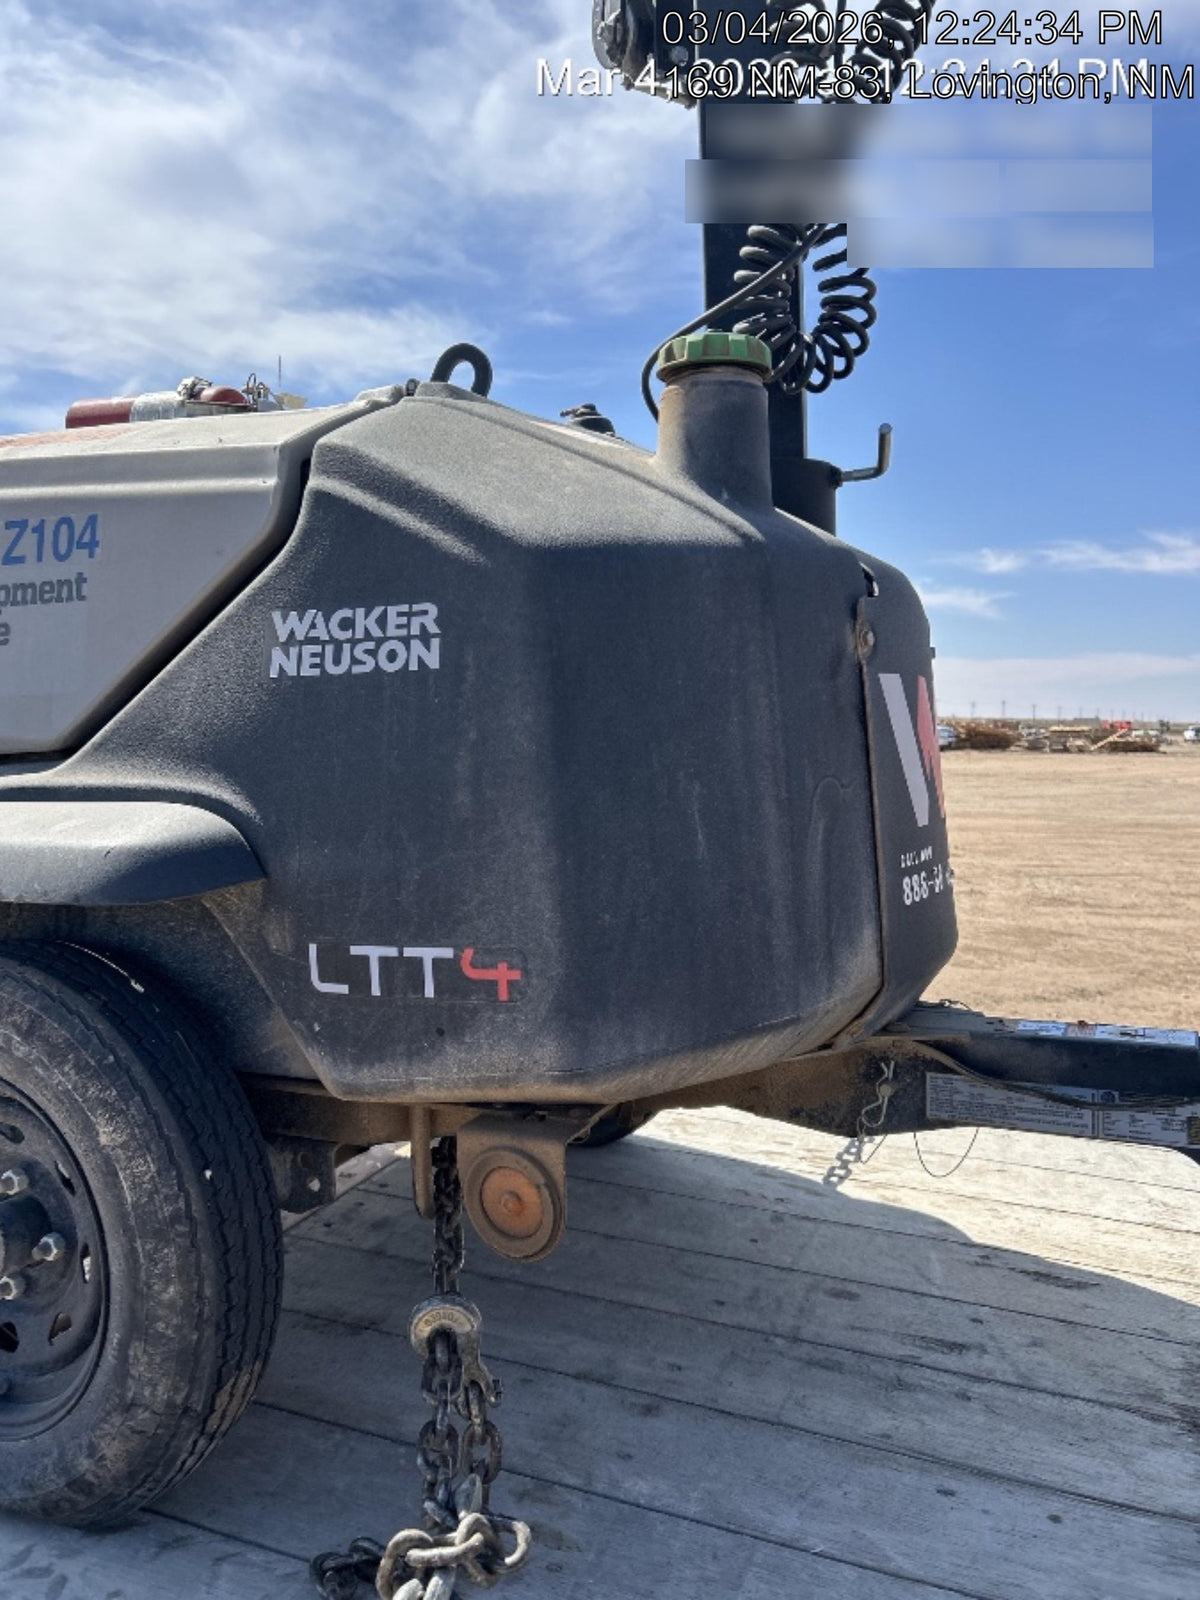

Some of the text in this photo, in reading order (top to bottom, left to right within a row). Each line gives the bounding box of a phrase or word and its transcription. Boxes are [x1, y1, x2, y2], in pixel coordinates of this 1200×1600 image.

[2, 513, 100, 566] Z104
[271, 602, 441, 642] WACKER
[269, 637, 441, 678] NEUSON
